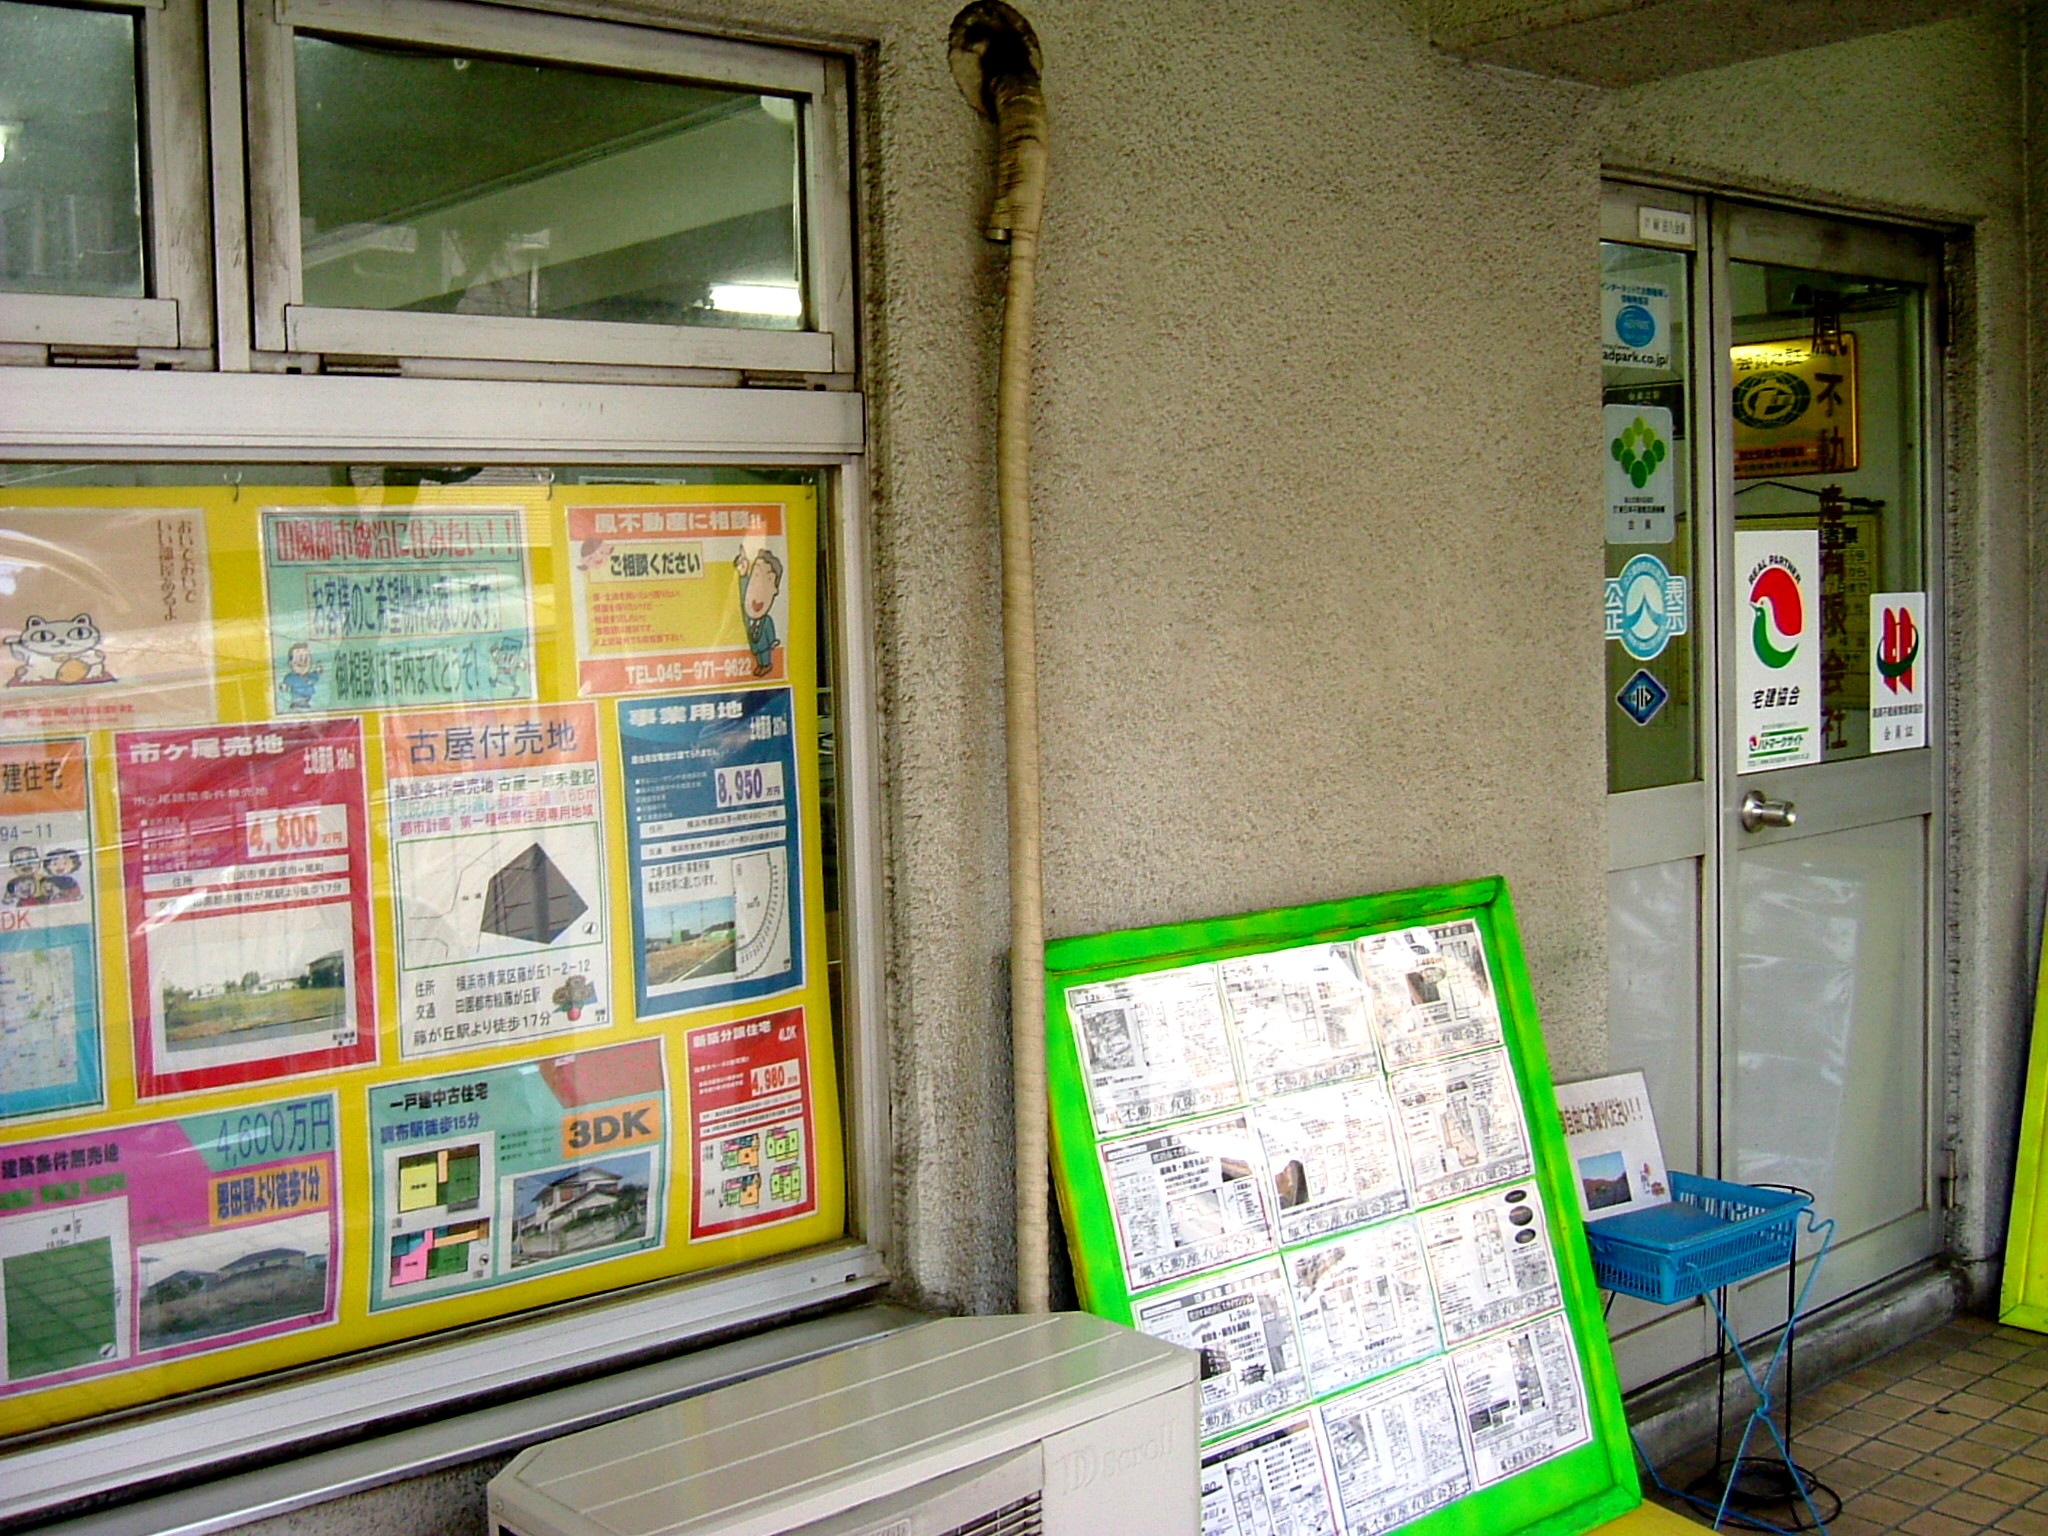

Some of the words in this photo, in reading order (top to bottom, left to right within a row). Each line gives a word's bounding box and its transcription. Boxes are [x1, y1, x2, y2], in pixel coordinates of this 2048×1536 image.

[610, 552, 701, 578] ご相談ください
[1748, 558, 1768, 585] REAL
[1769, 554, 1802, 584] PARTNER
[1605, 583, 1624, 634] 公正
[1665, 580, 1685, 630] 表示
[1752, 685, 1801, 710] 宅建協会
[405, 718, 579, 764] 古屋付売地
[415, 979, 436, 998] 住所
[415, 1003, 437, 1020] 交通
[413, 1012, 552, 1047] 藤が丘駅より徒歩17分
[567, 1107, 652, 1150] 3DK
